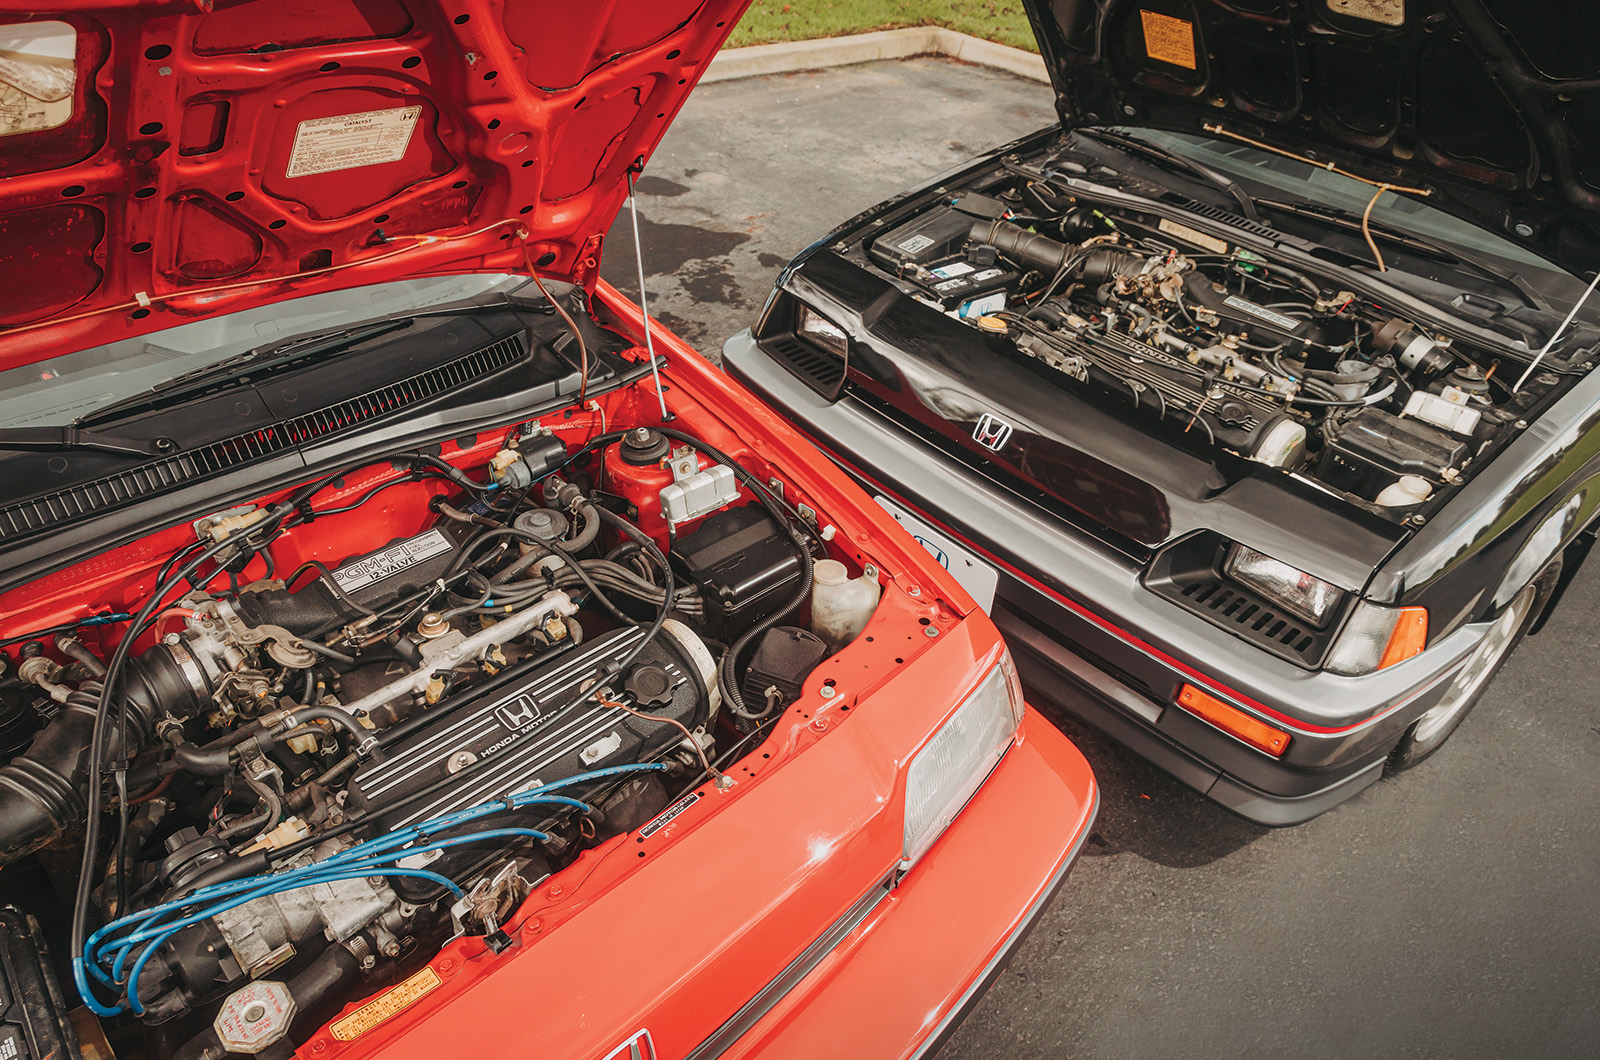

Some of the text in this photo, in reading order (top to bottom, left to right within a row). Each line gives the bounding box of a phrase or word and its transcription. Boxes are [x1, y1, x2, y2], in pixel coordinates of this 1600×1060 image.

[344, 119, 373, 127] CATALYST
[1122, 337, 1180, 367] HONDA
[406, 531, 438, 547] PROGRAMMED
[411, 540, 436, 553] INJECTION
[369, 555, 418, 580] 12-VALVE
[480, 733, 521, 758] HONDA
[356, 1000, 380, 1016] DANGER
